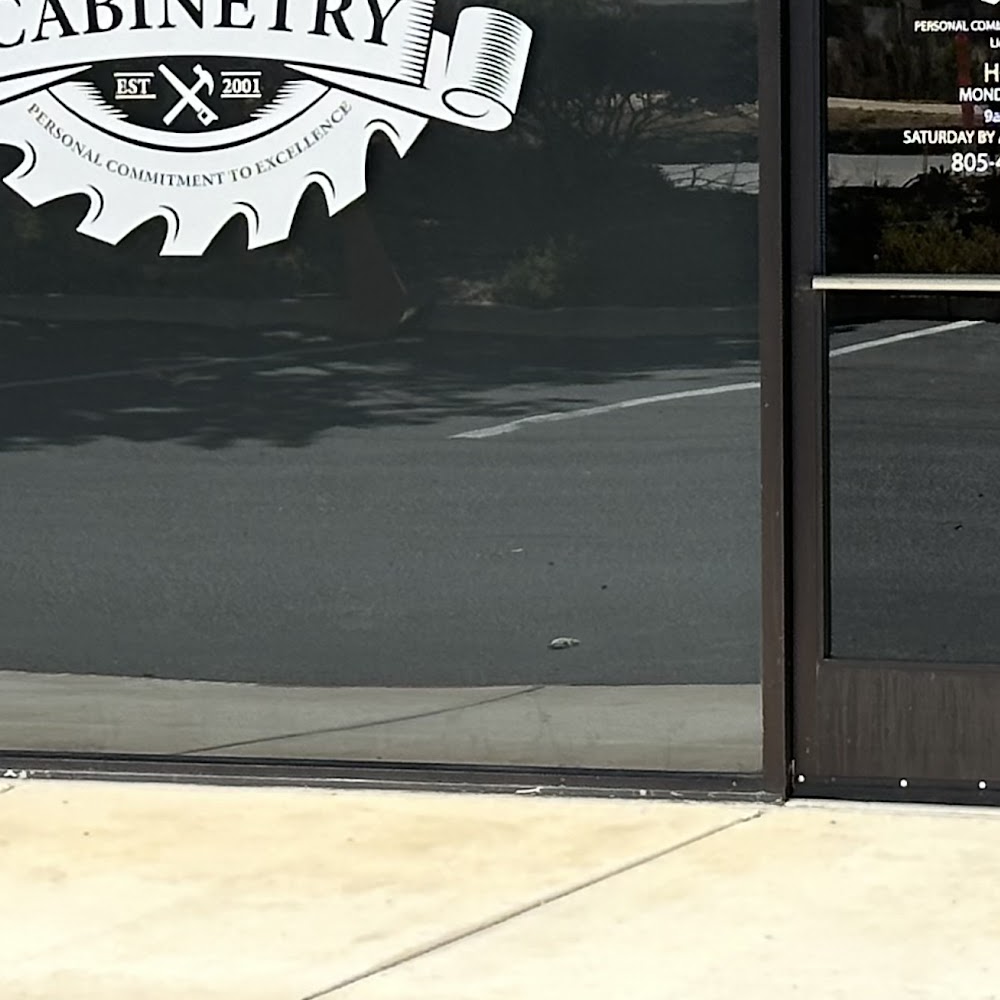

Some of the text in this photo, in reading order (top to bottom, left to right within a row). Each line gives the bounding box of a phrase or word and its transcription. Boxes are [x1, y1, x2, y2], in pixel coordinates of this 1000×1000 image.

[914, 20, 969, 32] PERSONAL
[116, 77, 262, 96] EST 2001
[27, 100, 354, 187] PERSONAL COMMITMENT TO EXCELLENCE
[903, 130, 975, 145] SATURDAY
[977, 130, 996, 144] BY
